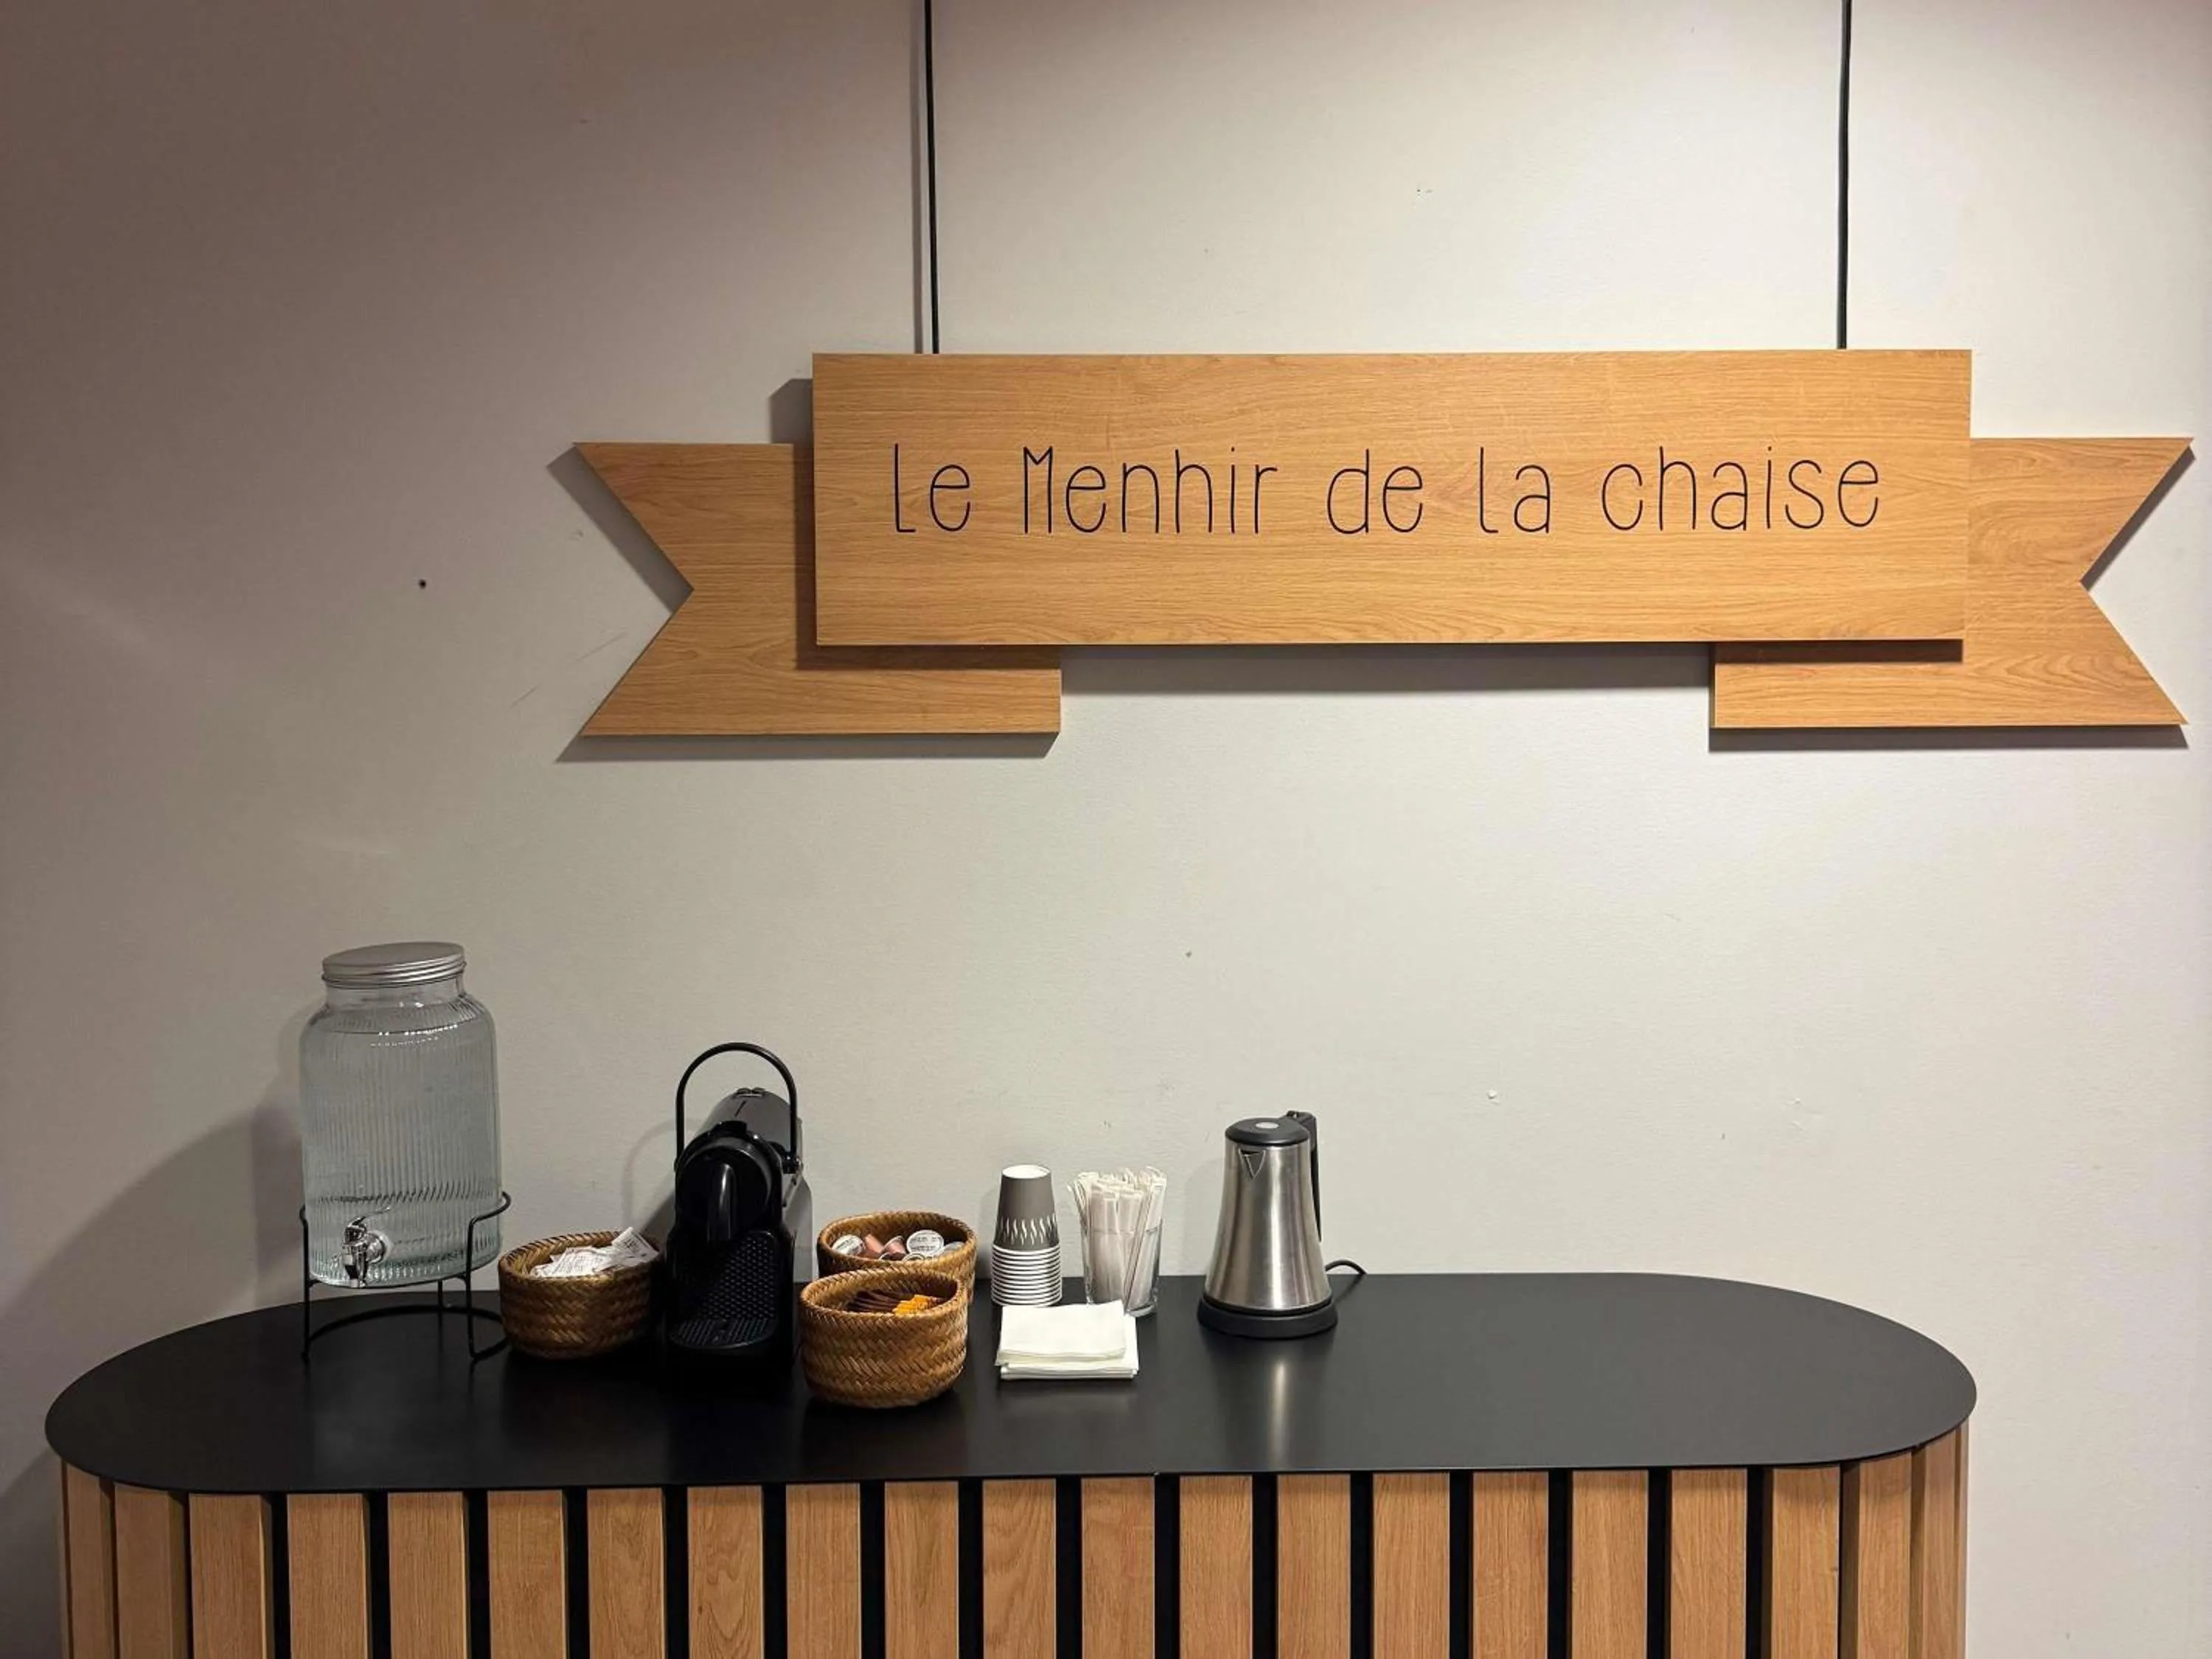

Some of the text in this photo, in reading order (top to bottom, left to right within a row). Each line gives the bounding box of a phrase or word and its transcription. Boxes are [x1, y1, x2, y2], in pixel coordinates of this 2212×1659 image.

[894, 444, 1879, 535] Le Menhir de la chaise
